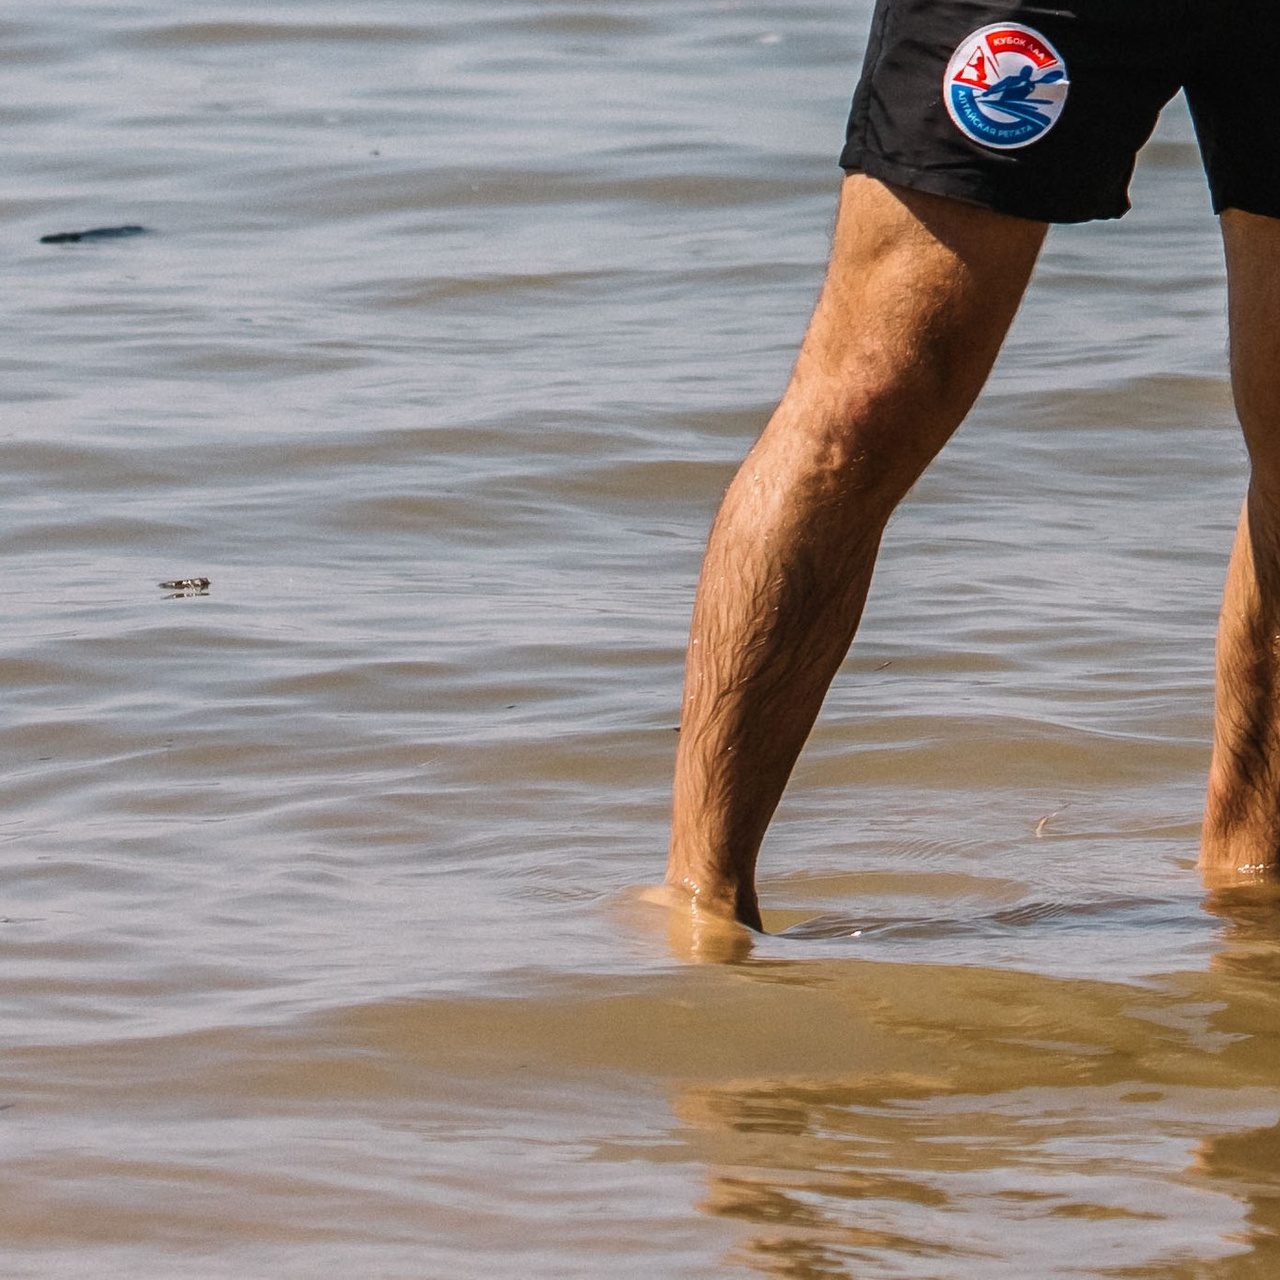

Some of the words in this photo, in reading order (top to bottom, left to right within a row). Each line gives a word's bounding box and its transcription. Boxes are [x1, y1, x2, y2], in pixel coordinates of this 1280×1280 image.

[993, 36, 1027, 47] КУБОК
[958, 90, 997, 136] АЛТАЙСКАЯ
[997, 124, 1035, 138] РЕГАТА
